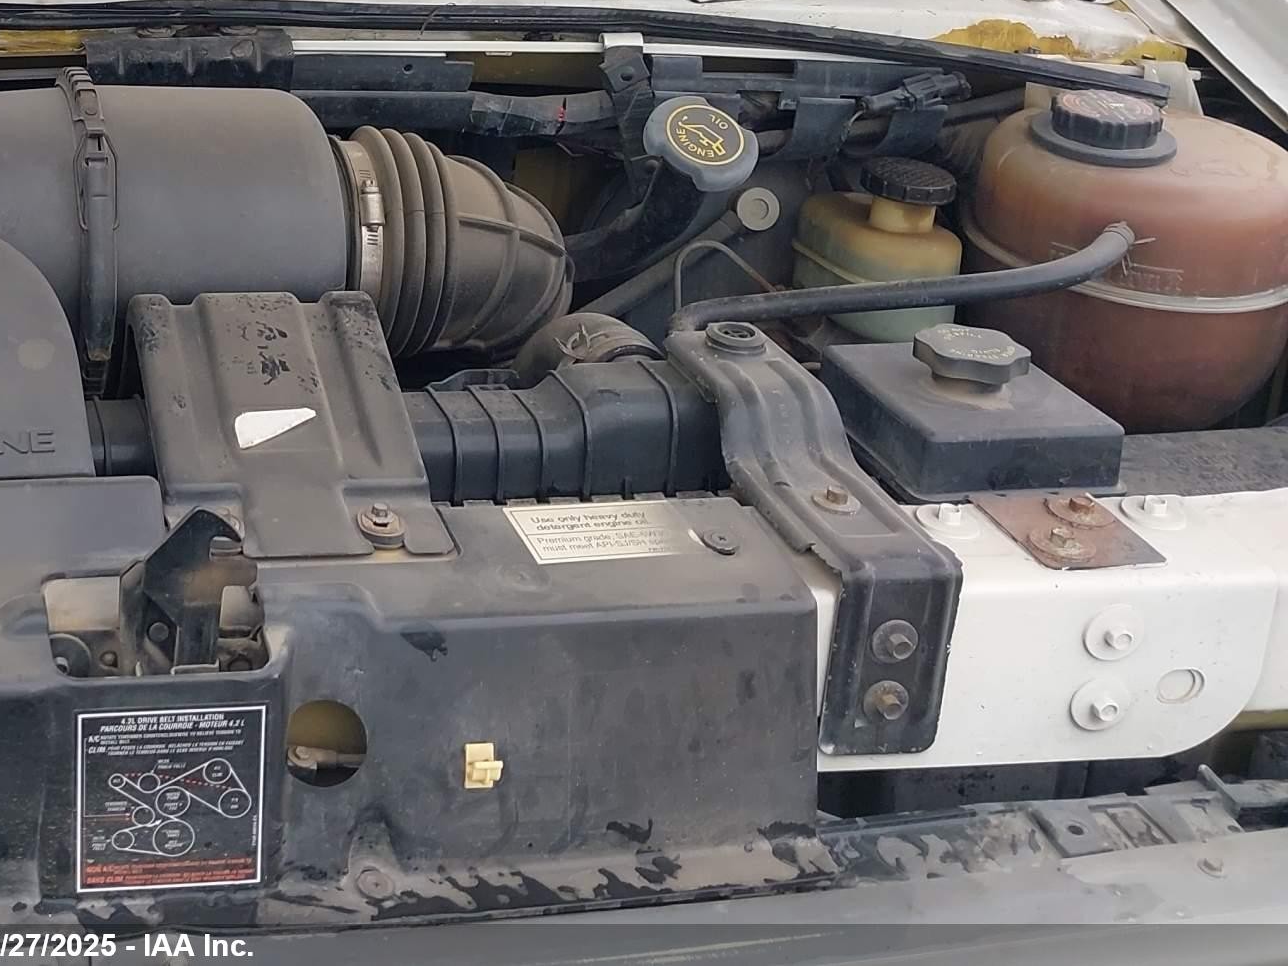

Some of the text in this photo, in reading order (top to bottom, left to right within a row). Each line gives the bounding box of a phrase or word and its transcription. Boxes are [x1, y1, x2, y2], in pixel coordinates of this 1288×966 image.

[708, 113, 729, 130] OIL
[675, 127, 715, 158] ENGINE
[530, 511, 646, 524] Use only heavy duty
[537, 522, 592, 532] detergent
[594, 520, 632, 529] engine
[177, 714, 225, 722] INSTALLATION
[100, 724, 137, 733] PARCOURS
[149, 723, 158, 731] LA
[159, 722, 193, 730] COURROIE
[199, 720, 227, 728] MOTEUR
[87, 876, 105, 884] SANS
